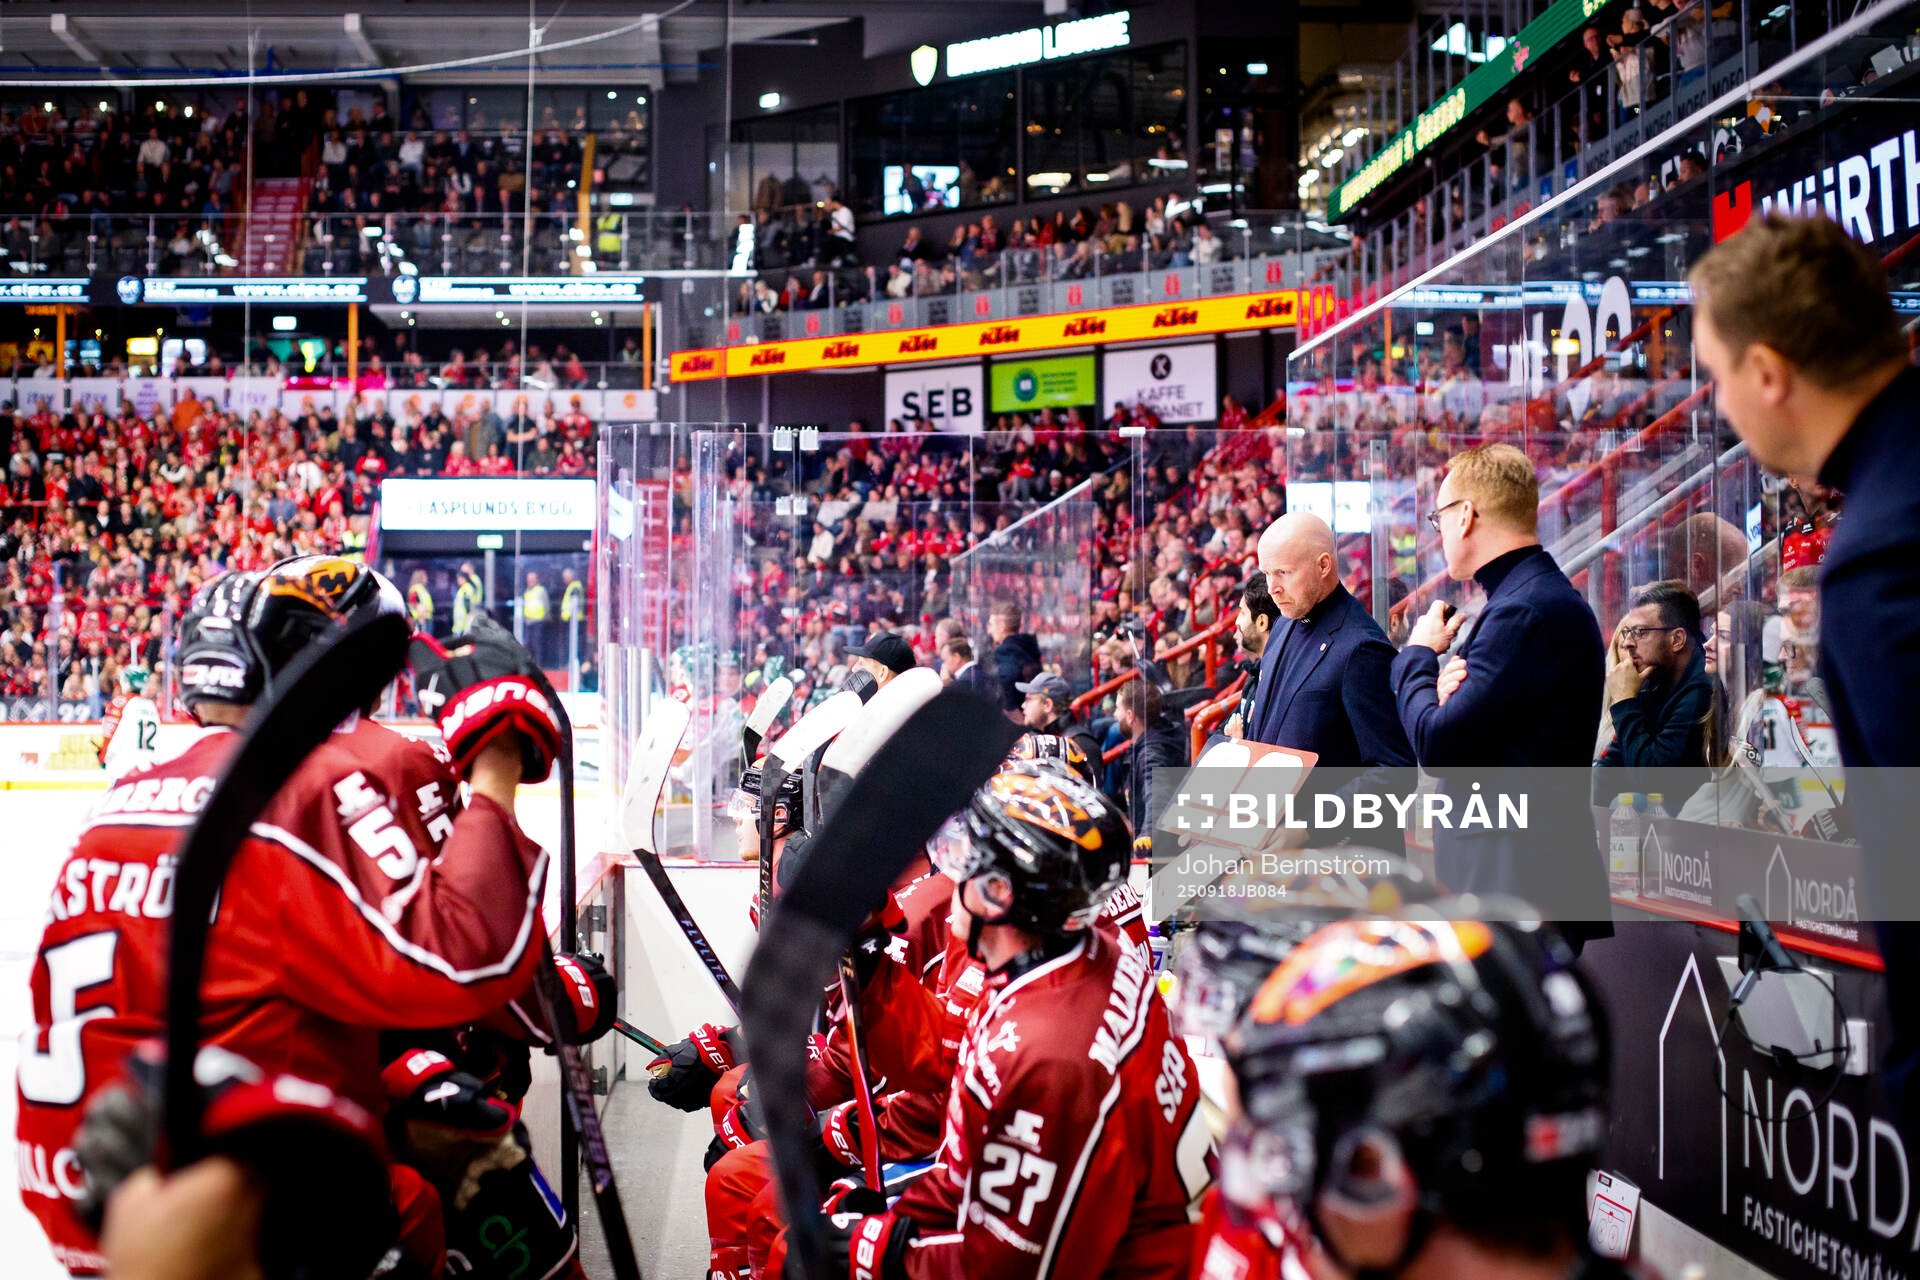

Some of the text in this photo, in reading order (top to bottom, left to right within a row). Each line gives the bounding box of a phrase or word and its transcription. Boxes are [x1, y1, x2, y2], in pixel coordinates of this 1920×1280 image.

[902, 387, 973, 422] SEB
[1137, 384, 1185, 402] KAFFE
[429, 501, 574, 516] ASPLUNDS BYGG
[137, 719, 157, 751] 12
[92, 775, 217, 816] BERG
[348, 805, 418, 880] 5
[46, 853, 219, 924] STRÖ
[1664, 850, 1712, 889] NORDÅ
[1101, 880, 1141, 917] BER
[1794, 876, 1859, 923] NORDÅ
[680, 918, 728, 981] FLYLITE
[1743, 1069, 1920, 1251] NORD
[979, 1142, 1058, 1227] 27
[1744, 1195, 1908, 1280] FASTIGHETSMÄ
